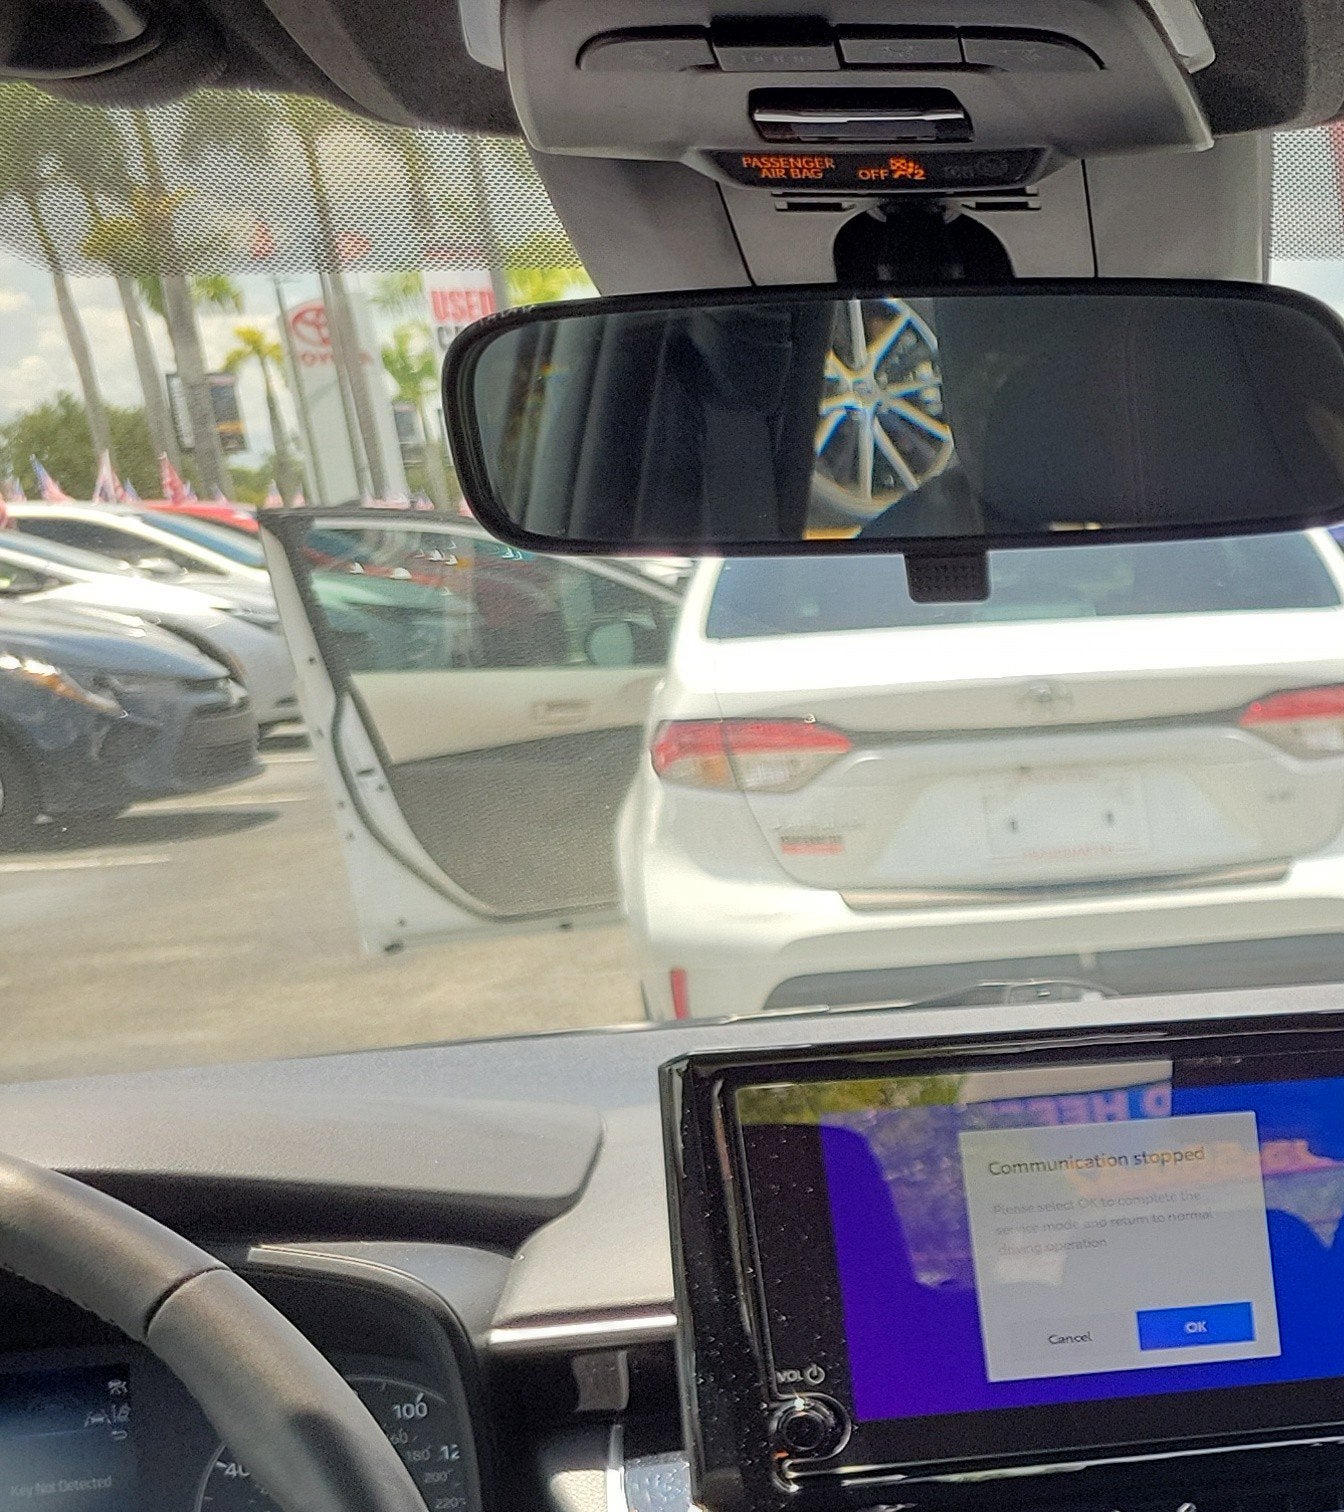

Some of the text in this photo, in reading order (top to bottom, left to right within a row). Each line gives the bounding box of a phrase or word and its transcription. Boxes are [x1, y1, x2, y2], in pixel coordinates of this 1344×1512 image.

[742, 156, 836, 169] PASSENGER
[761, 168, 787, 179] AIR
[791, 168, 823, 179] BAG
[858, 169, 889, 180] OFF
[989, 1147, 1205, 1176] Communication stopped
[1048, 1321, 1208, 1345] Cancel OK
[777, 1370, 804, 1383] VOL
[392, 1402, 428, 1419] 100
[58, 1475, 112, 1491] Detected
